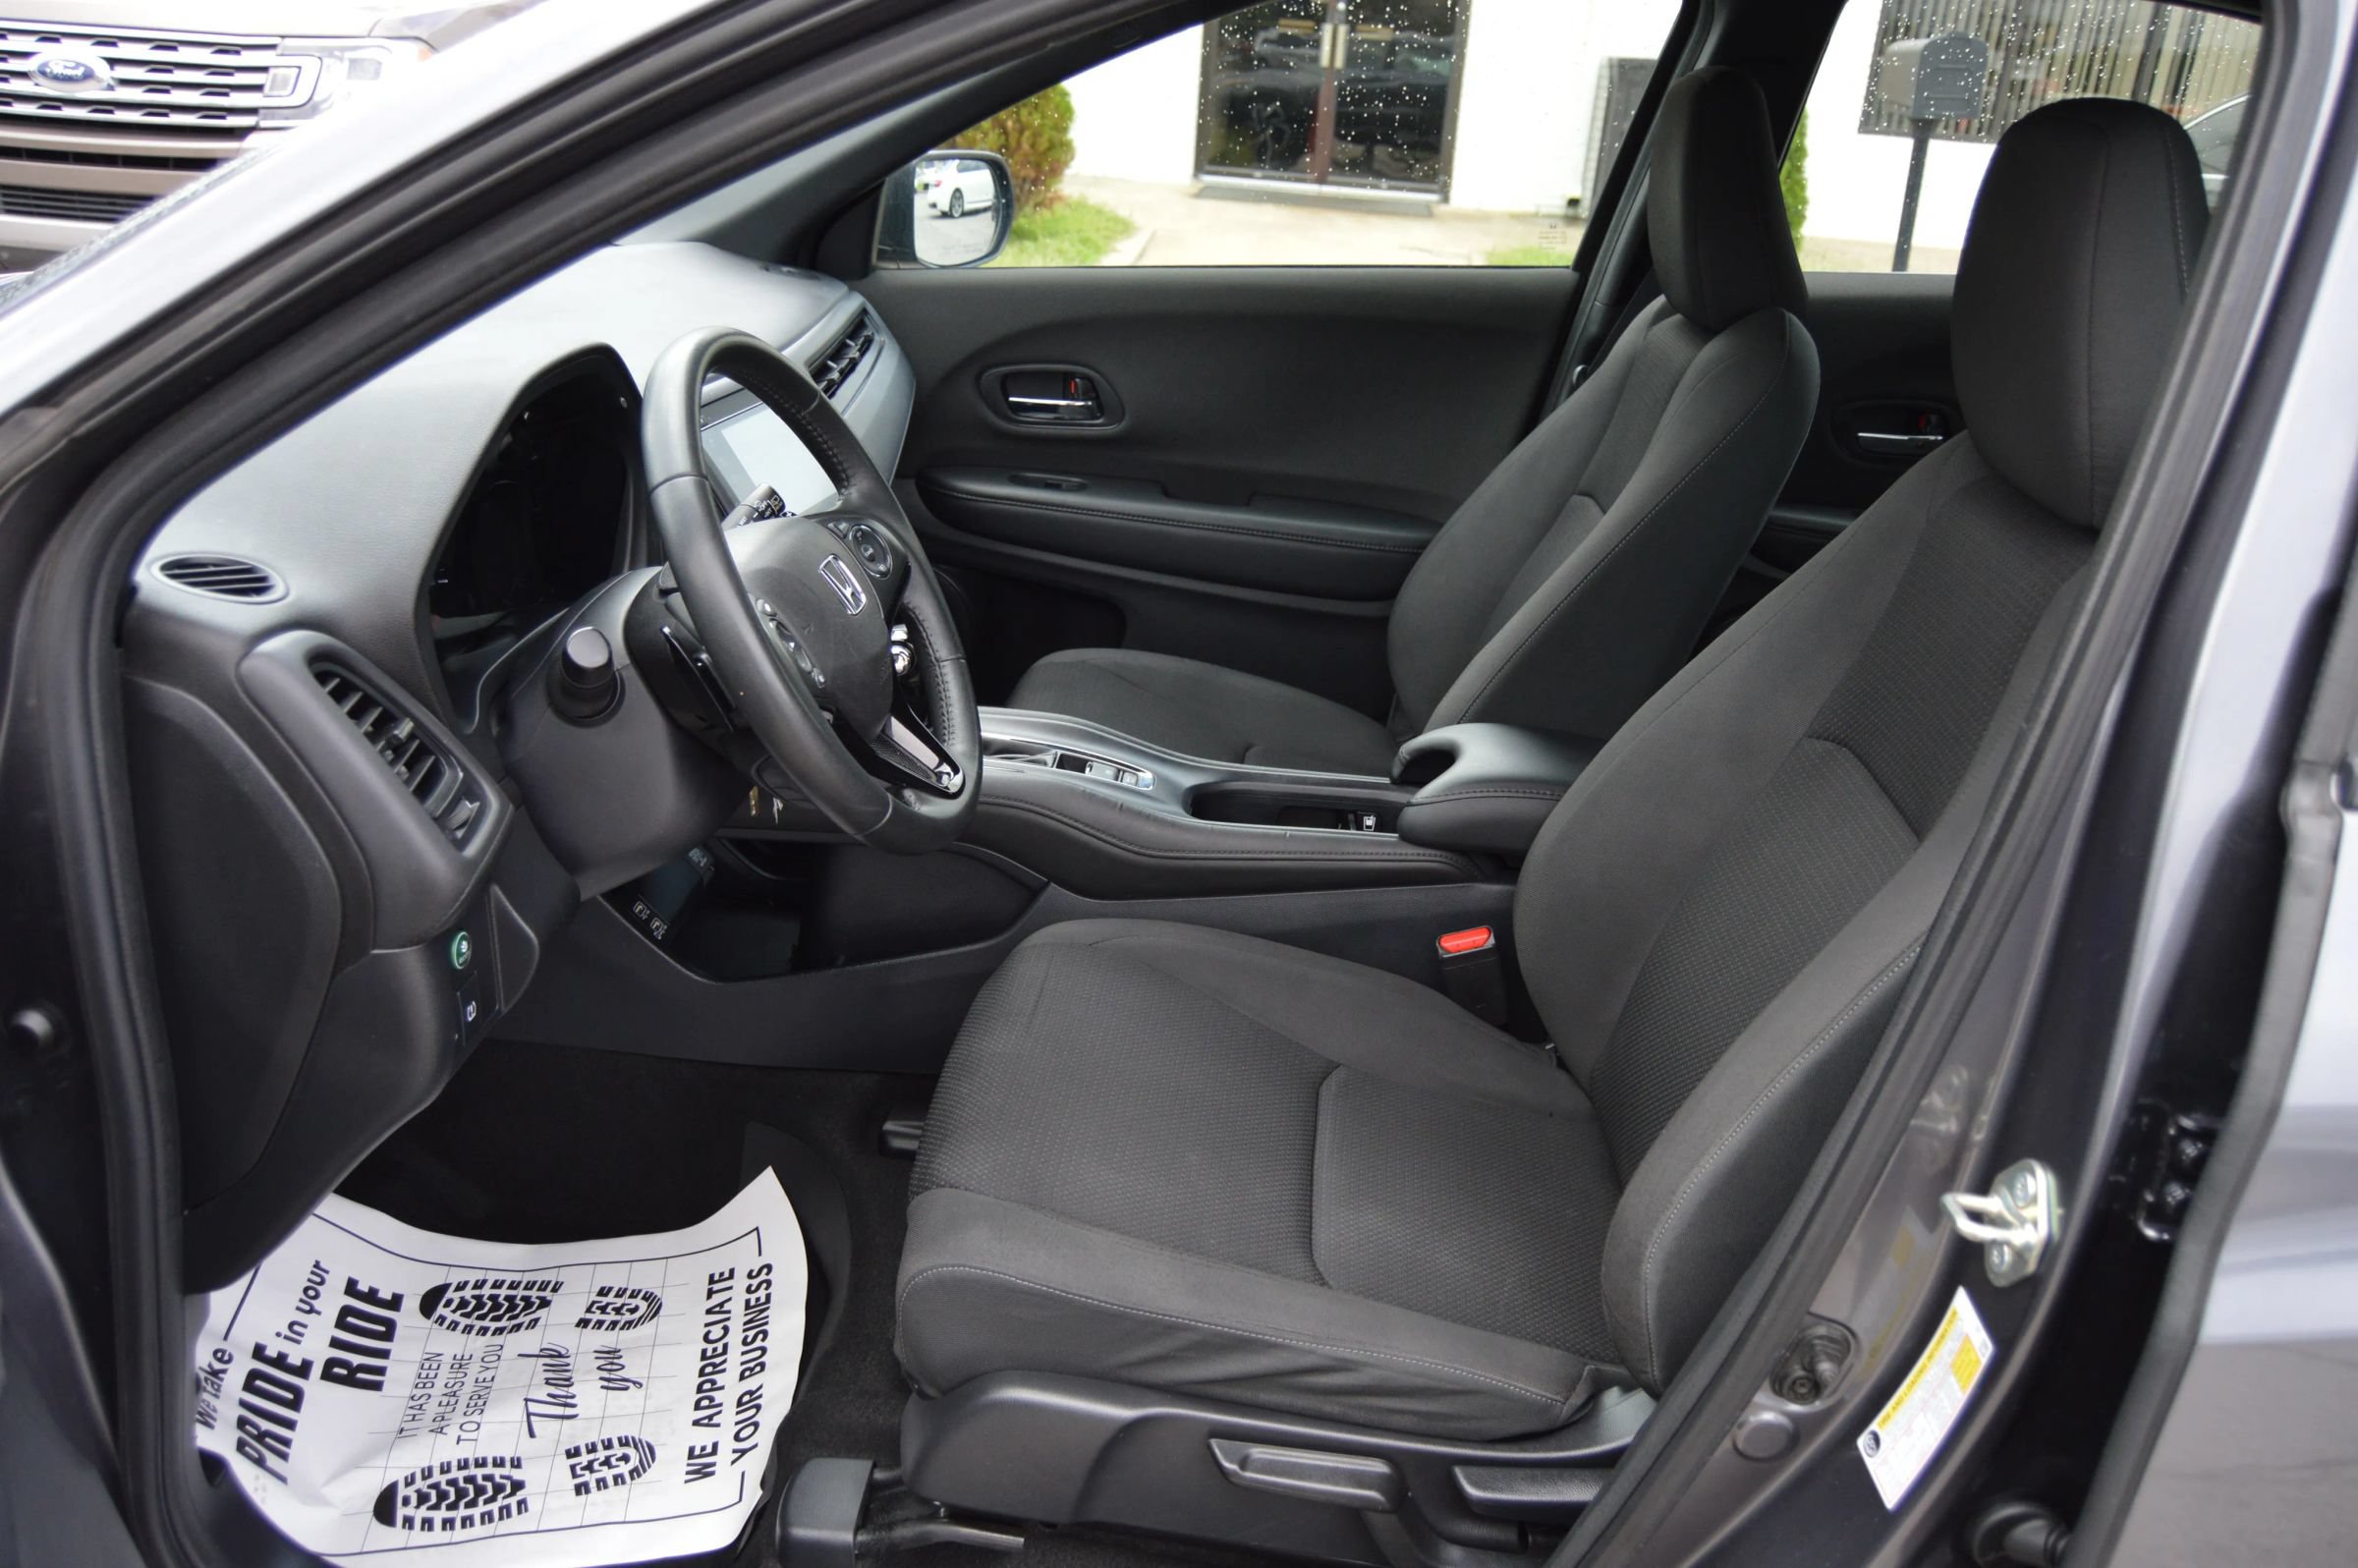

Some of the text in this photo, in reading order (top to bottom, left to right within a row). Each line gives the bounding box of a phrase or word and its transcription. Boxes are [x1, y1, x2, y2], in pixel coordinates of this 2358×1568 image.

[46, 61, 85, 78] Ford
[236, 1260, 330, 1486] PRIDE in your
[320, 1276, 404, 1392] RIDE
[592, 1345, 644, 1391] you
[684, 1266, 735, 1484] WE APPRECIATE
[730, 1262, 773, 1467] YOUR BUSINESS
[398, 1352, 444, 1438] IT HAS BEEN
[428, 1353, 473, 1435] A PLEASURE
[456, 1343, 504, 1445] TO SERVE YOU
[517, 1342, 580, 1438] Thank
